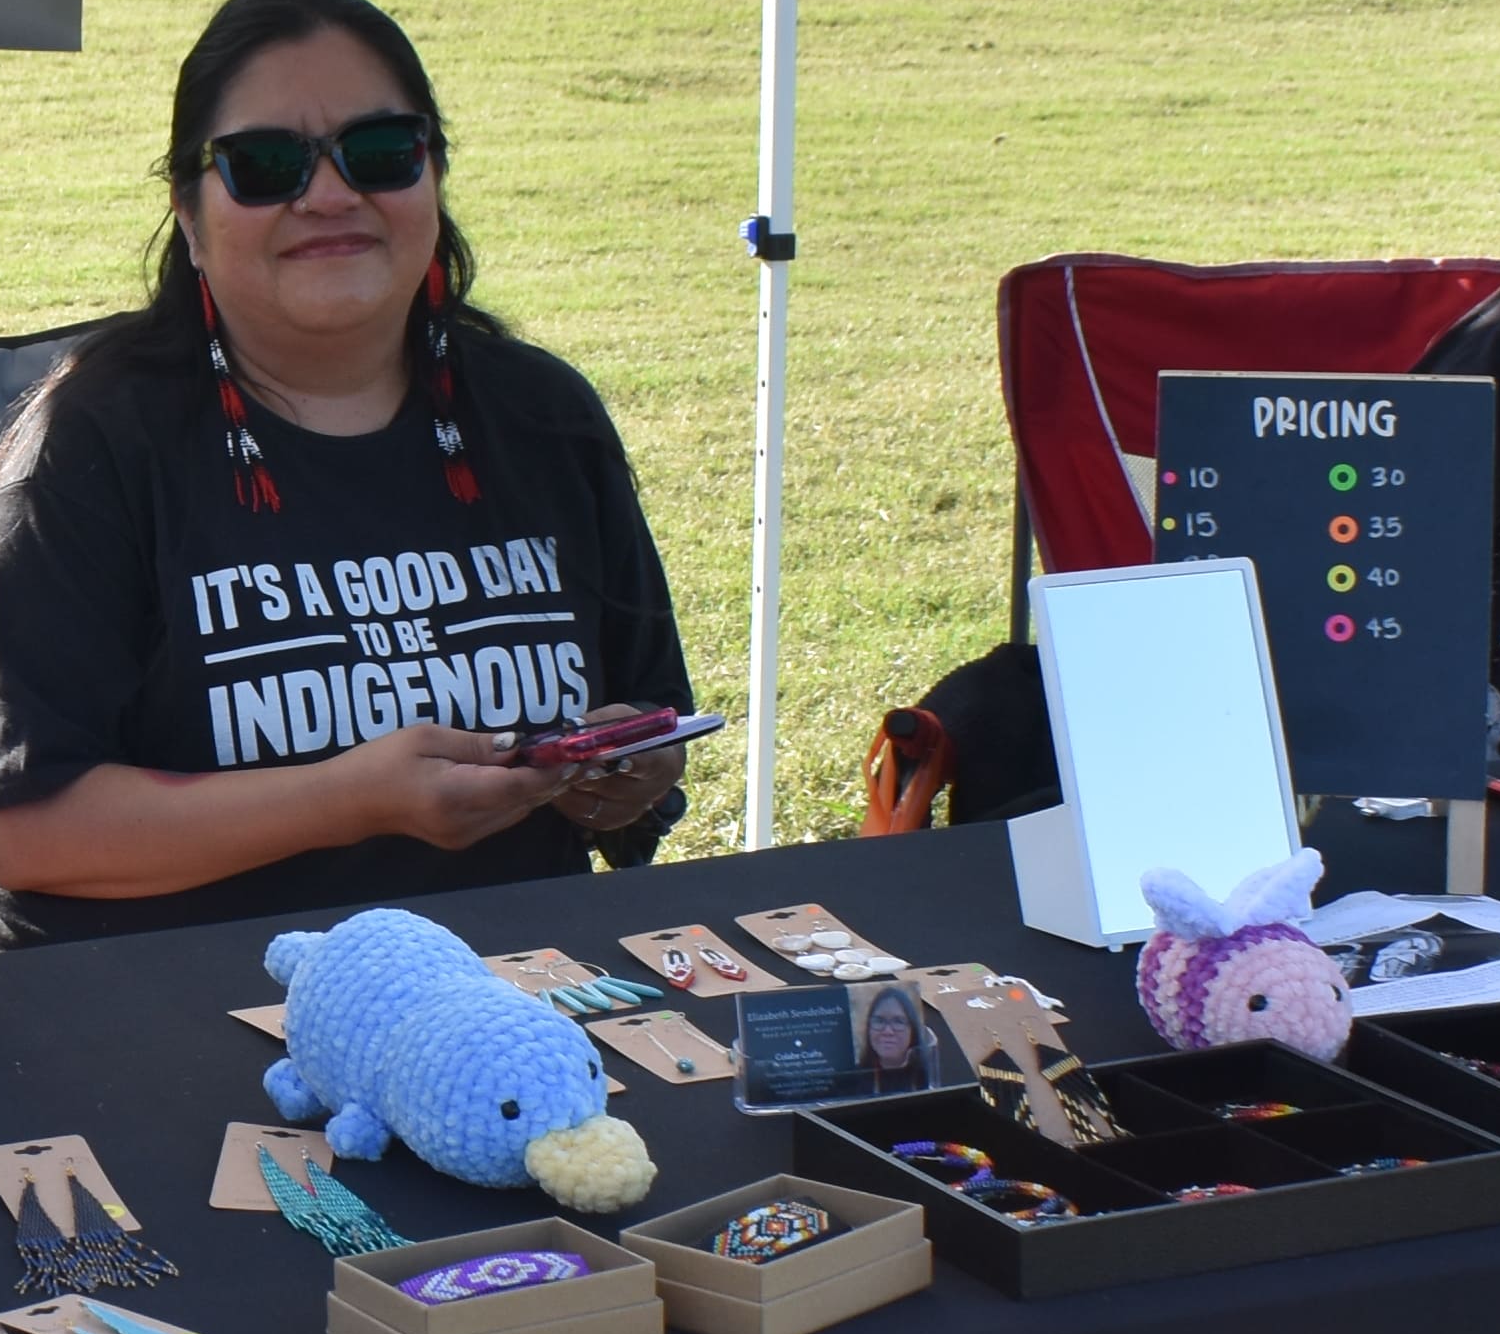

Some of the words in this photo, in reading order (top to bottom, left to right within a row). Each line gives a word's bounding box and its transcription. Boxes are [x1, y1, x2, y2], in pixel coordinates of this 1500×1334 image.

[1253, 396, 1399, 439] PRICING
[1188, 467, 1219, 489] 10
[1370, 467, 1406, 488] 30
[1185, 512, 1218, 538] 15
[1368, 516, 1403, 539] 35
[192, 563, 290, 635] IT'S
[294, 561, 332, 618] A
[334, 550, 467, 618] GOOD
[470, 535, 563, 597] DAY
[1366, 568, 1400, 587] 40
[351, 622, 390, 657] TO
[400, 616, 438, 654] BE
[1365, 616, 1402, 640] 45
[209, 640, 590, 767] INDIGENOUS
